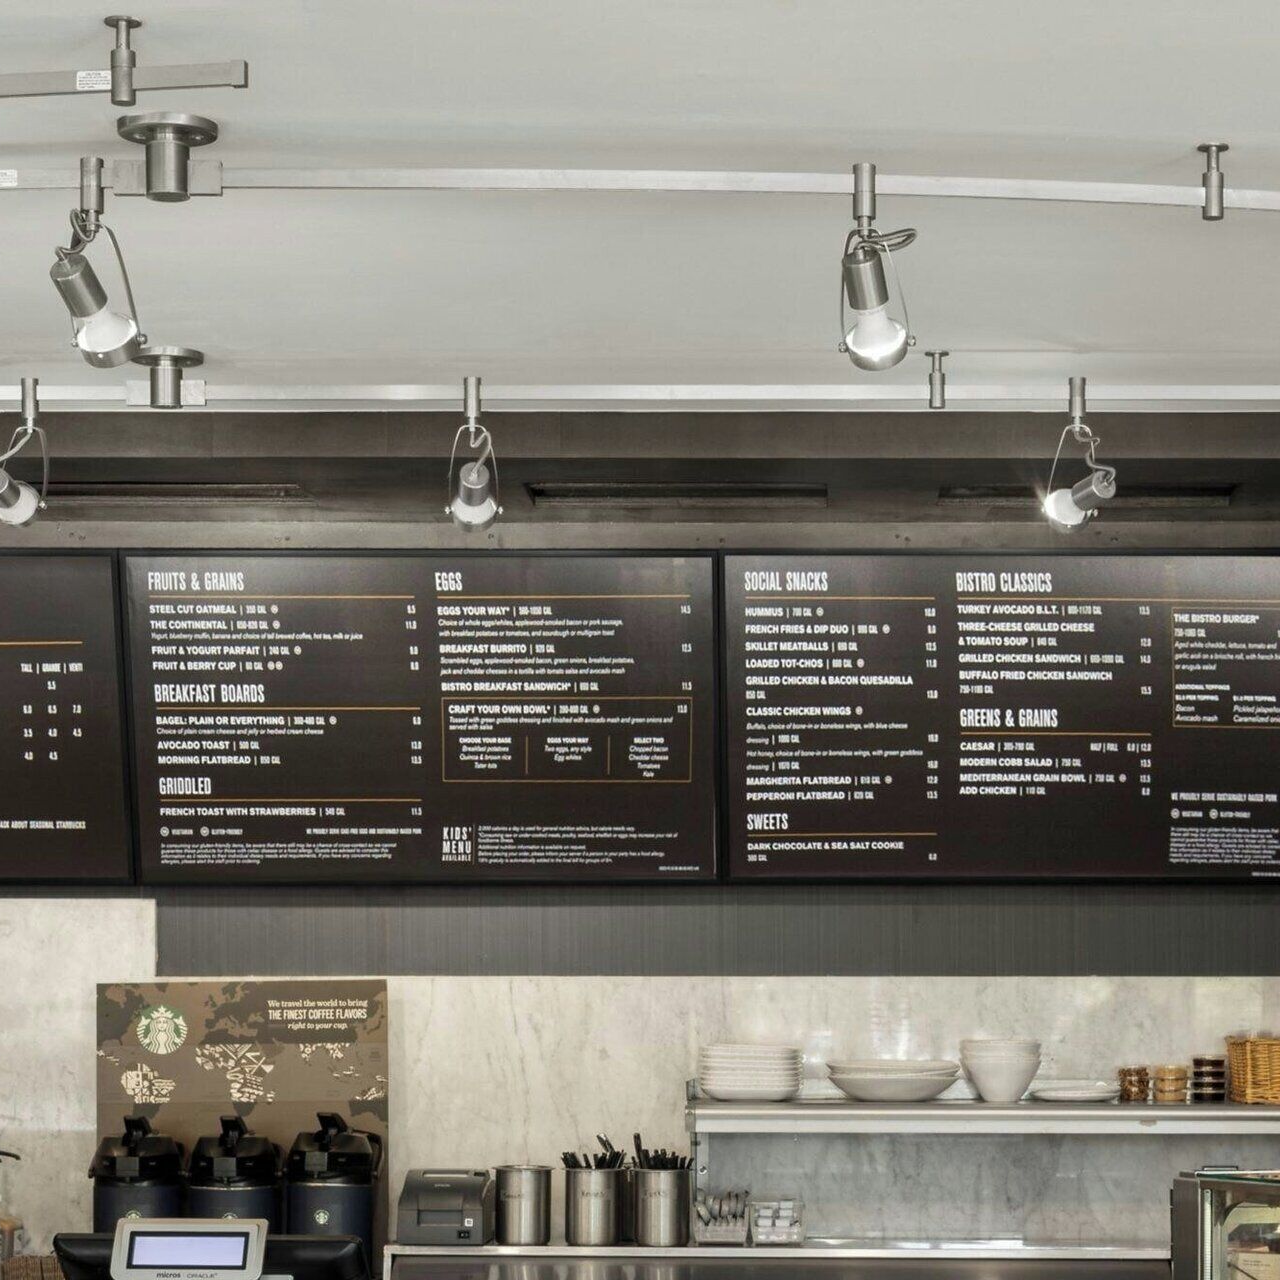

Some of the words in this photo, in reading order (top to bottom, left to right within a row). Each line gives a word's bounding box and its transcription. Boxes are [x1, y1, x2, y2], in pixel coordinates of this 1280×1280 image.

[148, 572, 186, 590] FRUITS
[191, 573, 200, 590] &
[205, 572, 244, 590] GRAINS
[435, 572, 462, 590] EGGS
[745, 572, 782, 590] SOCIAL
[786, 572, 828, 591] SNACKS
[956, 573, 996, 591] BISTRO
[1000, 573, 1052, 592] CLASSICS
[149, 605, 177, 613] STEEL
[177, 605, 195, 613] CUT
[196, 605, 236, 613] OATMEAL
[745, 608, 783, 616] HUMMUS
[150, 620, 168, 629] THE
[169, 621, 227, 629] CONTINENTAL
[957, 622, 1023, 631] THREE-CHEESE
[1024, 623, 1060, 631] GRILLED
[1059, 623, 1095, 632] CHEESE
[745, 625, 779, 633] FRENCH
[779, 625, 806, 633] FRIES
[805, 625, 813, 633] &
[814, 625, 829, 633] DIP
[830, 625, 849, 634] DUO
[958, 637, 965, 645] &
[965, 637, 1003, 645] TOMATO
[1004, 637, 1028, 646] SOUP
[152, 646, 177, 654] FRUIT
[177, 646, 186, 654] &
[186, 646, 222, 654] YOGURT
[223, 646, 260, 654] PARFAIT
[439, 645, 489, 653] BREAKFAST
[489, 644, 527, 653] BURRITO
[745, 642, 779, 651] SKILLET
[780, 642, 828, 651] MEATBALLS
[746, 659, 780, 668] LOADED
[781, 659, 823, 668] TOT-CHOS
[441, 682, 473, 691] BISTRO
[474, 682, 522, 691] BREAKFAST
[154, 684, 216, 702] BREAKFAST
[221, 684, 264, 702] BOARDS
[449, 705, 476, 713] CRAFT
[477, 705, 501, 713] YOUR
[502, 705, 522, 713] OWN
[746, 707, 783, 715] CLASSIC
[783, 707, 822, 715] CHICKEN
[821, 707, 851, 715] WINGS
[156, 716, 188, 724] BAGEL:
[215, 716, 230, 724] OR
[230, 717, 285, 725] EVERYTHING
[960, 709, 1000, 727] GREENS
[1005, 709, 1014, 727] &
[1019, 709, 1058, 727] GRAINS
[158, 741, 201, 749] AVOCADO
[202, 741, 230, 749] TOAST
[960, 742, 995, 750] CAESAR
[158, 756, 200, 764] MORNING
[200, 756, 251, 764] FLATBREAD
[747, 777, 802, 785] MARGHERITA
[803, 776, 851, 784] FLATBREAD
[1061, 774, 1086, 782] BOWL
[159, 778, 211, 794] GRIDDLED
[747, 792, 796, 800] PEPPERONI
[747, 814, 788, 829] SWEETS
[443, 839, 471, 856] MENU
[771, 842, 823, 850] CHOCOLATE
[268, 1009, 282, 1020] THE
[283, 1009, 307, 1020] FINEST
[308, 1009, 334, 1020] COFFEE
[336, 1009, 367, 1020] FLAVORS
